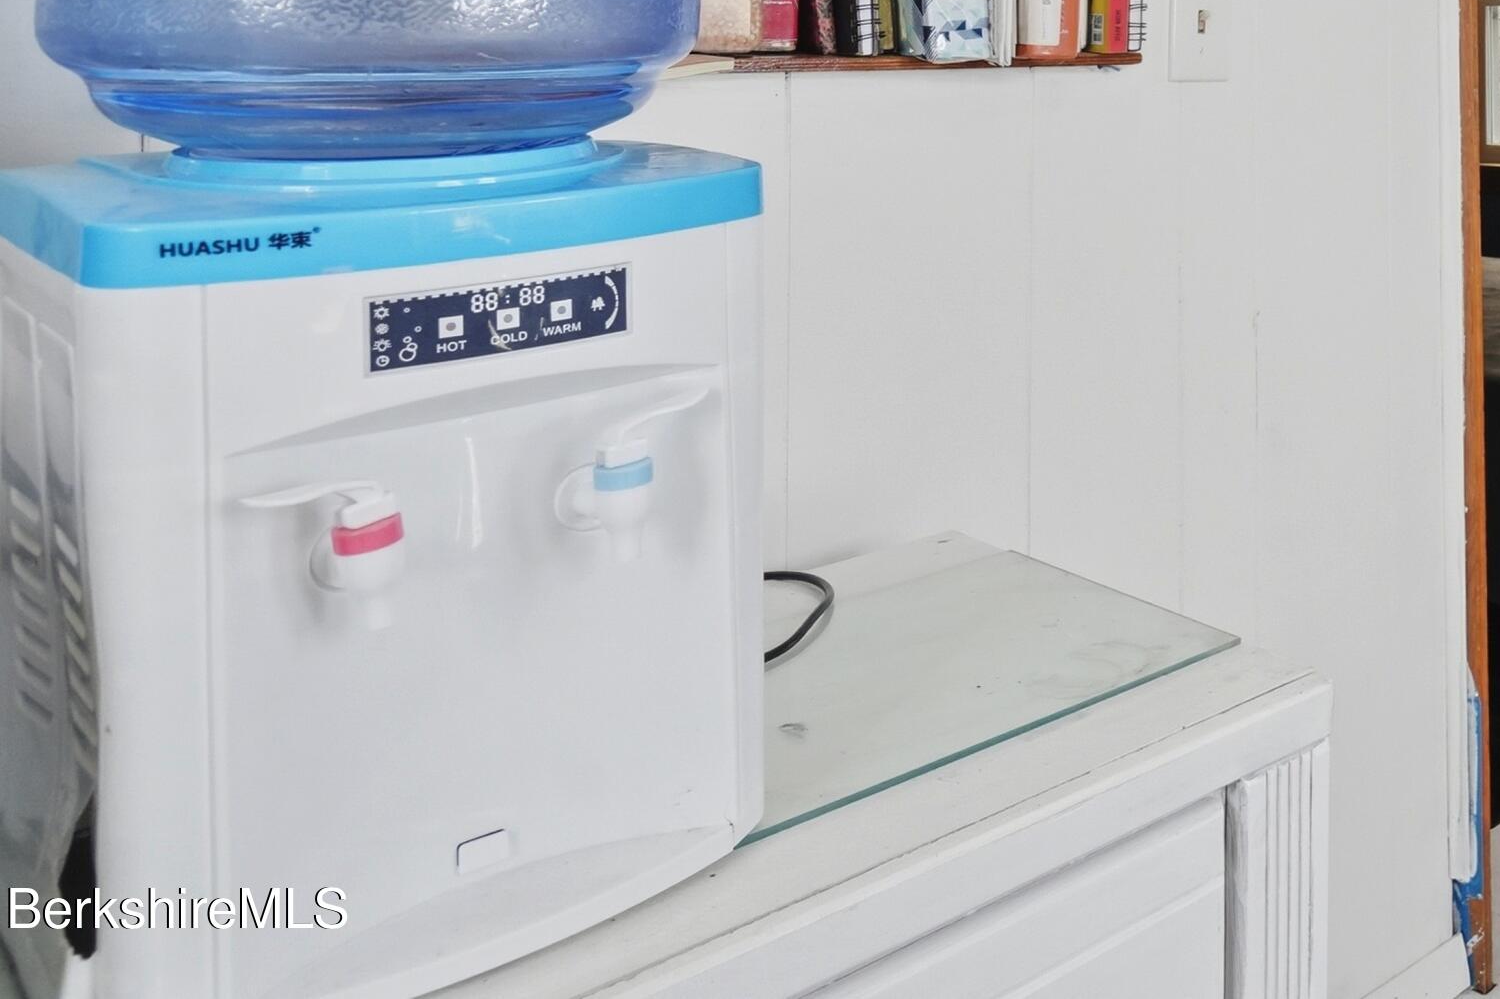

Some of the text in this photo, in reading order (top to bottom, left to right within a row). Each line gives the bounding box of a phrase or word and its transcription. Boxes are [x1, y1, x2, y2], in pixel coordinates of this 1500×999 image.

[159, 237, 260, 259] HUASHU
[542, 320, 582, 338] WARM
[435, 338, 468, 354] HOT
[490, 330, 528, 346] COLD
